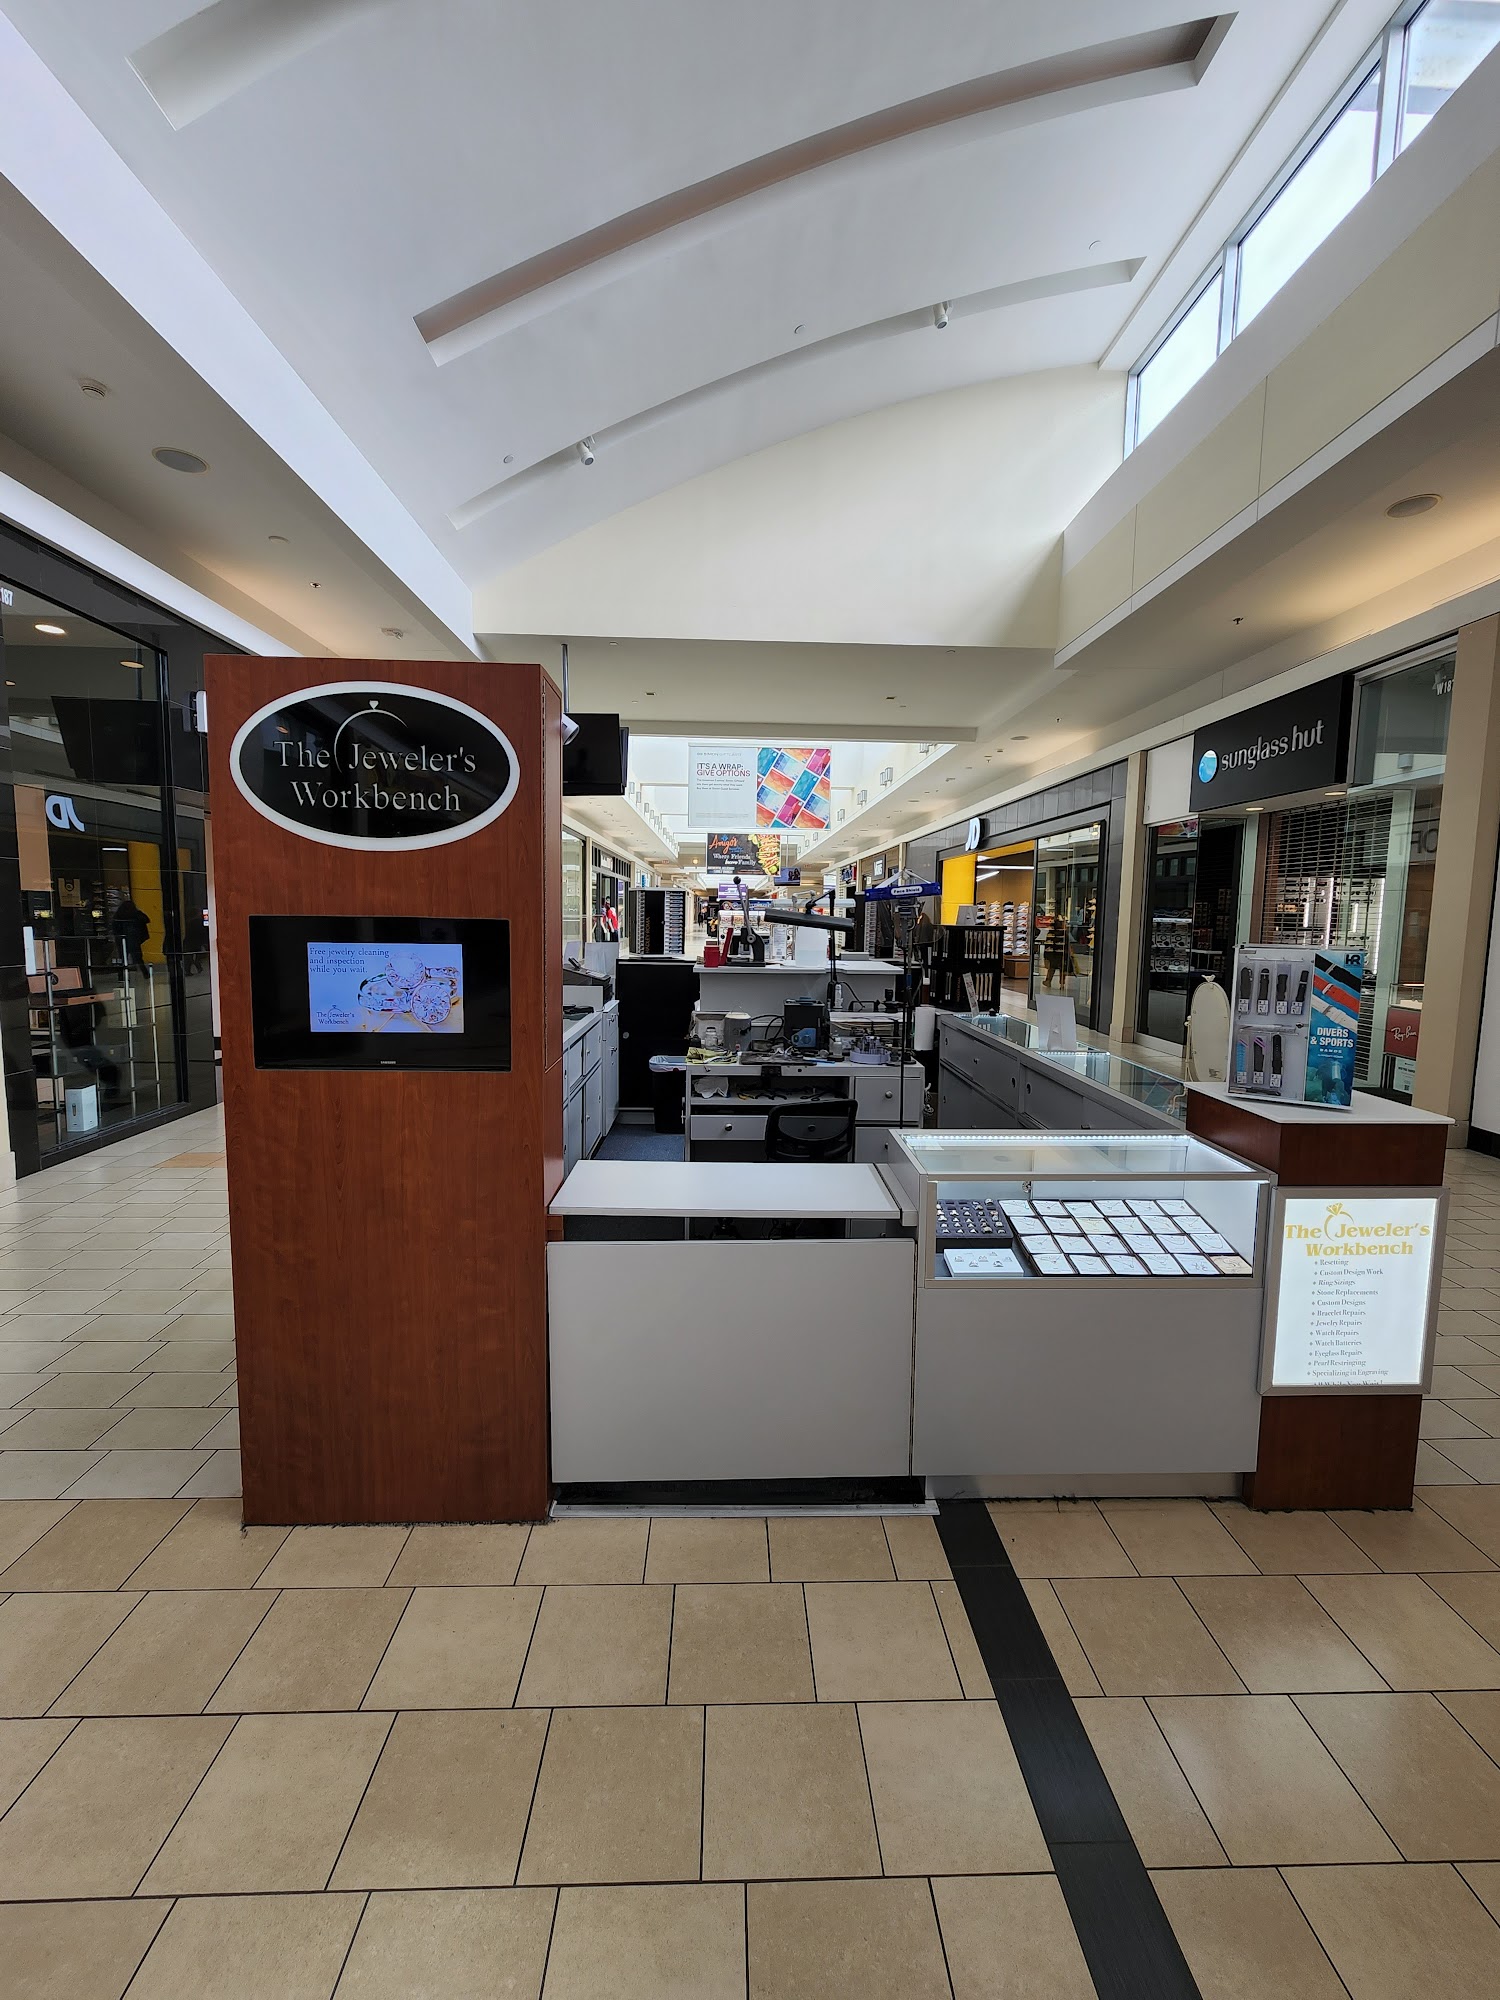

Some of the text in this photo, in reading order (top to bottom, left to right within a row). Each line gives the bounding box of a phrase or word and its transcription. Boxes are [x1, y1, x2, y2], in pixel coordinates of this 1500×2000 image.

[1221, 720, 1324, 771] sunglass hut
[273, 741, 476, 773] The Jeweler's
[718, 763, 744, 771] WRAP:
[290, 781, 461, 811] Workbench
[965, 817, 981, 851] JD
[328, 948, 355, 957] jewelry
[358, 948, 389, 958] cleaning
[309, 956, 365, 966] and inspection
[1345, 953, 1361, 965] HR
[309, 965, 330, 973] while
[333, 967, 347, 975] you
[1316, 1027, 1349, 1037] DIVERS
[1391, 1025, 1417, 1041] Ray-Ban
[1310, 1036, 1354, 1048] & SPORTS
[1285, 1223, 1431, 1239] The Jeweler's
[1305, 1241, 1413, 1257] Workbench
[1319, 1259, 1349, 1267] Resetting
[1343, 1268, 1366, 1277] Design
[1318, 1279, 1356, 1287] Ring Sizings
[1335, 1289, 1379, 1297] Replacements
[1341, 1299, 1366, 1307] Designs
[1342, 1309, 1367, 1317] Repairs
[1339, 1319, 1363, 1327] Repairs
[1314, 1349, 1363, 1358] Eyeglass Repairs
[1313, 1359, 1367, 1367] Pearl Restringing
[1312, 1370, 1350, 1378] Specializing
